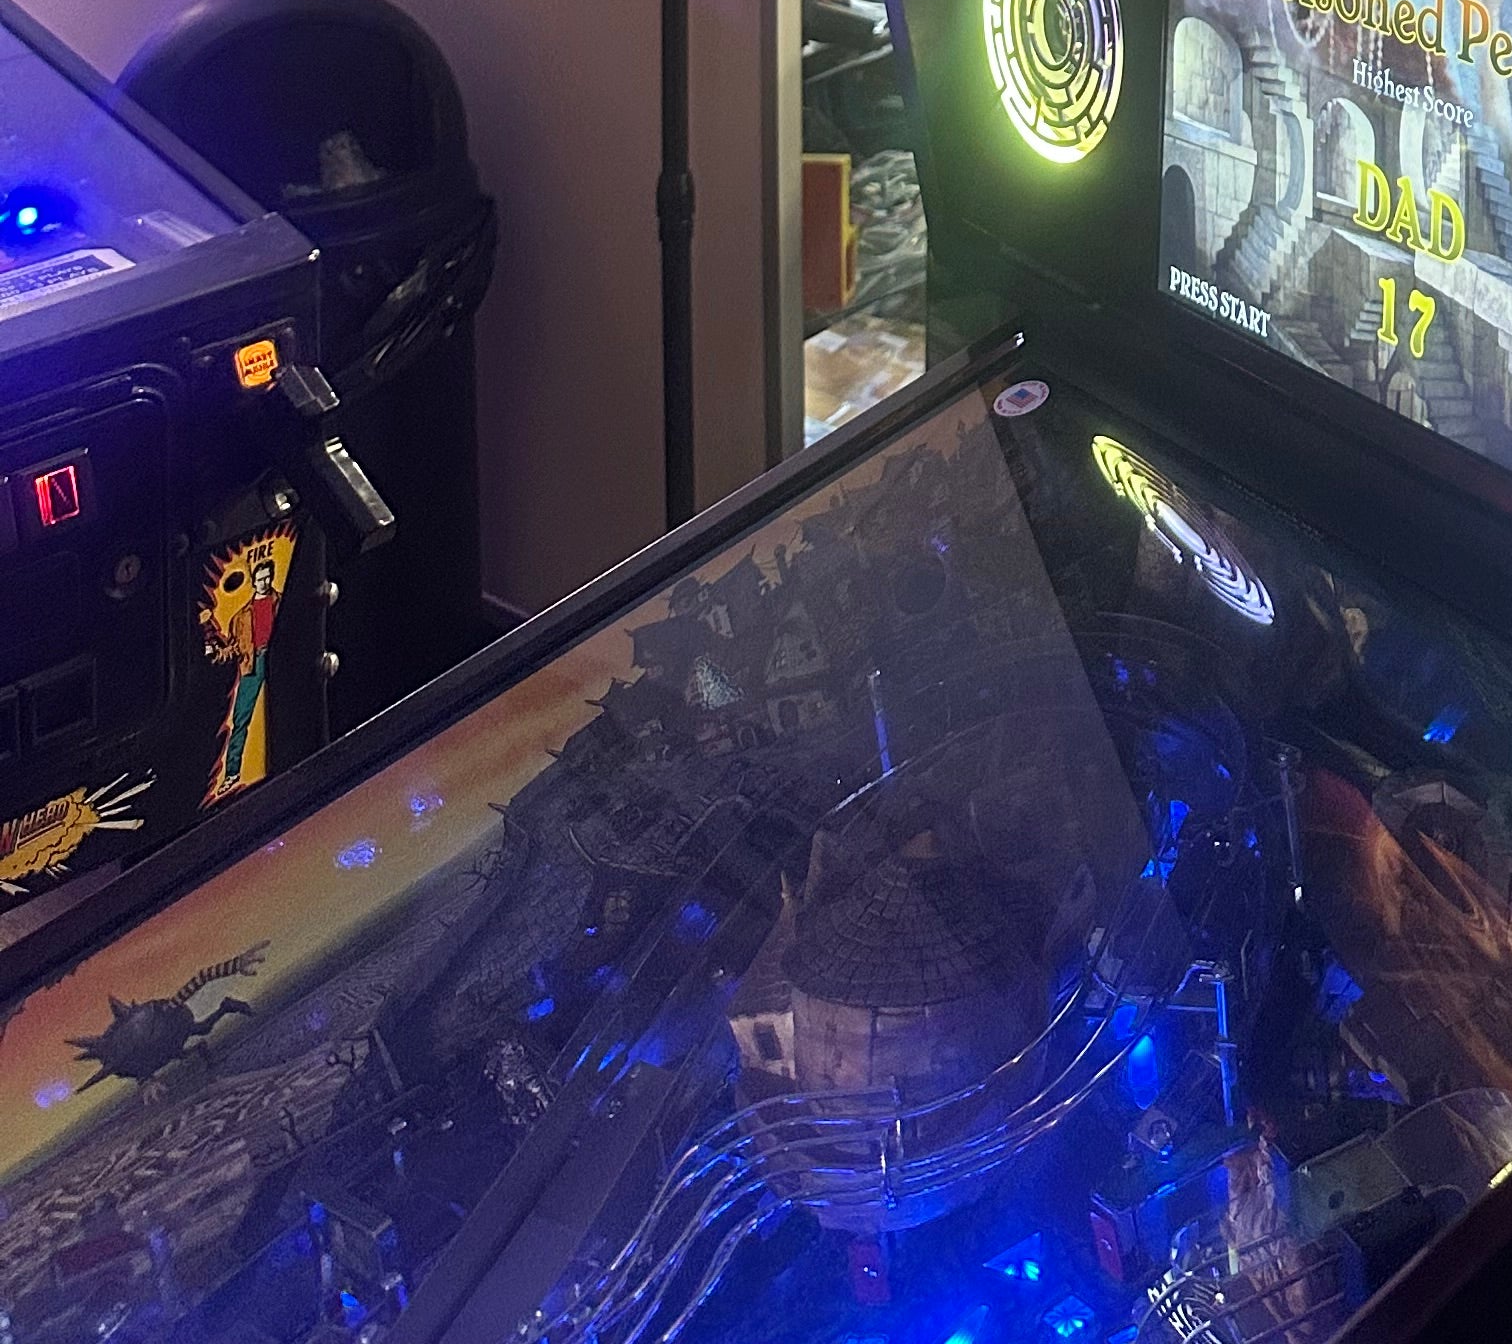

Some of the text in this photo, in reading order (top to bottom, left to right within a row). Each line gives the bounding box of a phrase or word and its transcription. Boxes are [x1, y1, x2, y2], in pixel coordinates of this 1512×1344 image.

[1351, 58, 1475, 129] Highest Score
[1352, 159, 1466, 265] DAD
[1169, 266, 1272, 339] PRESS START
[1376, 277, 1437, 359] 17
[246, 540, 275, 564] FIRE
[19, 800, 70, 840] HERO
